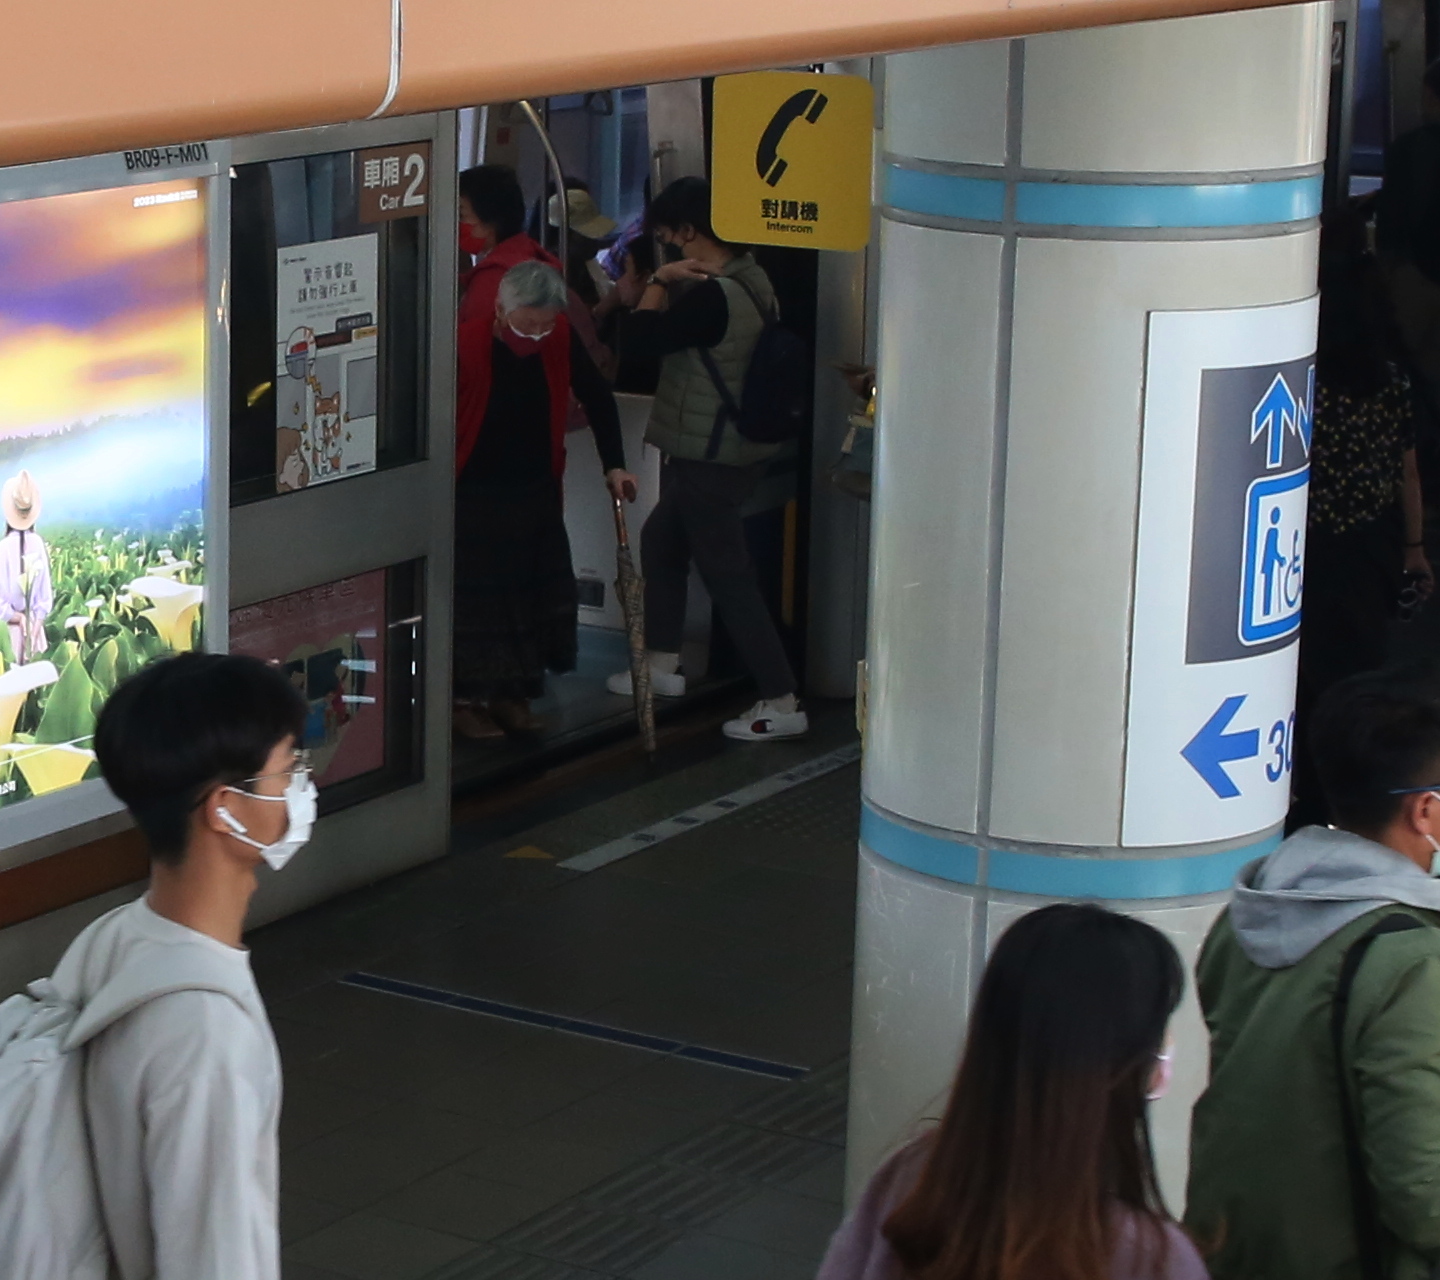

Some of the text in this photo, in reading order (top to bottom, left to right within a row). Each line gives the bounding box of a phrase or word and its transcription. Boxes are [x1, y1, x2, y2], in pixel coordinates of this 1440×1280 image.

[364, 153, 425, 207] 車廂 2
[380, 194, 400, 210] Car
[761, 199, 818, 222] 對講機
[767, 221, 813, 234] Intercom
